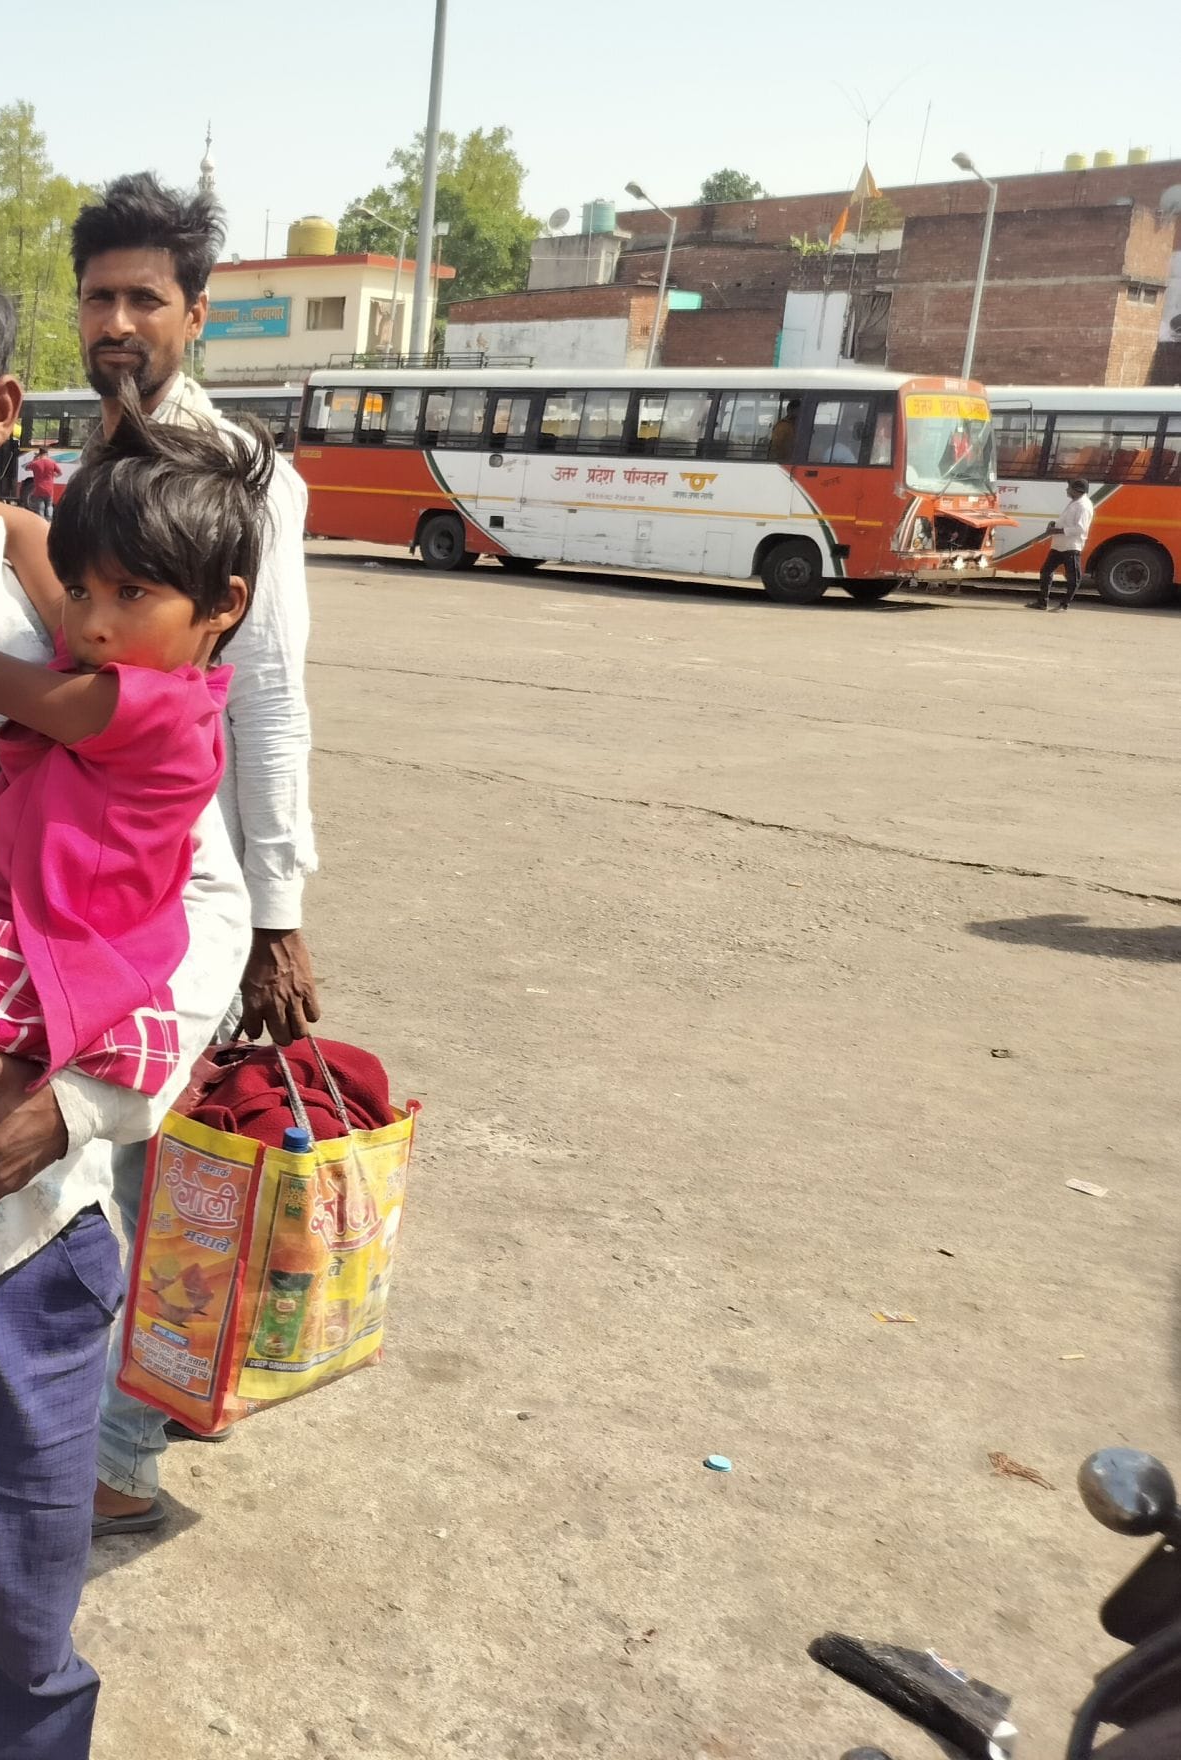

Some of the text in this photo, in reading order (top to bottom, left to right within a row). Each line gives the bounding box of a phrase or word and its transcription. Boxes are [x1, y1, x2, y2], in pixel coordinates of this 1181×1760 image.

[551, 466, 579, 482] उत्तर
[623, 467, 668, 488] परिवहन
[182, 1229, 234, 1255] मसाले
